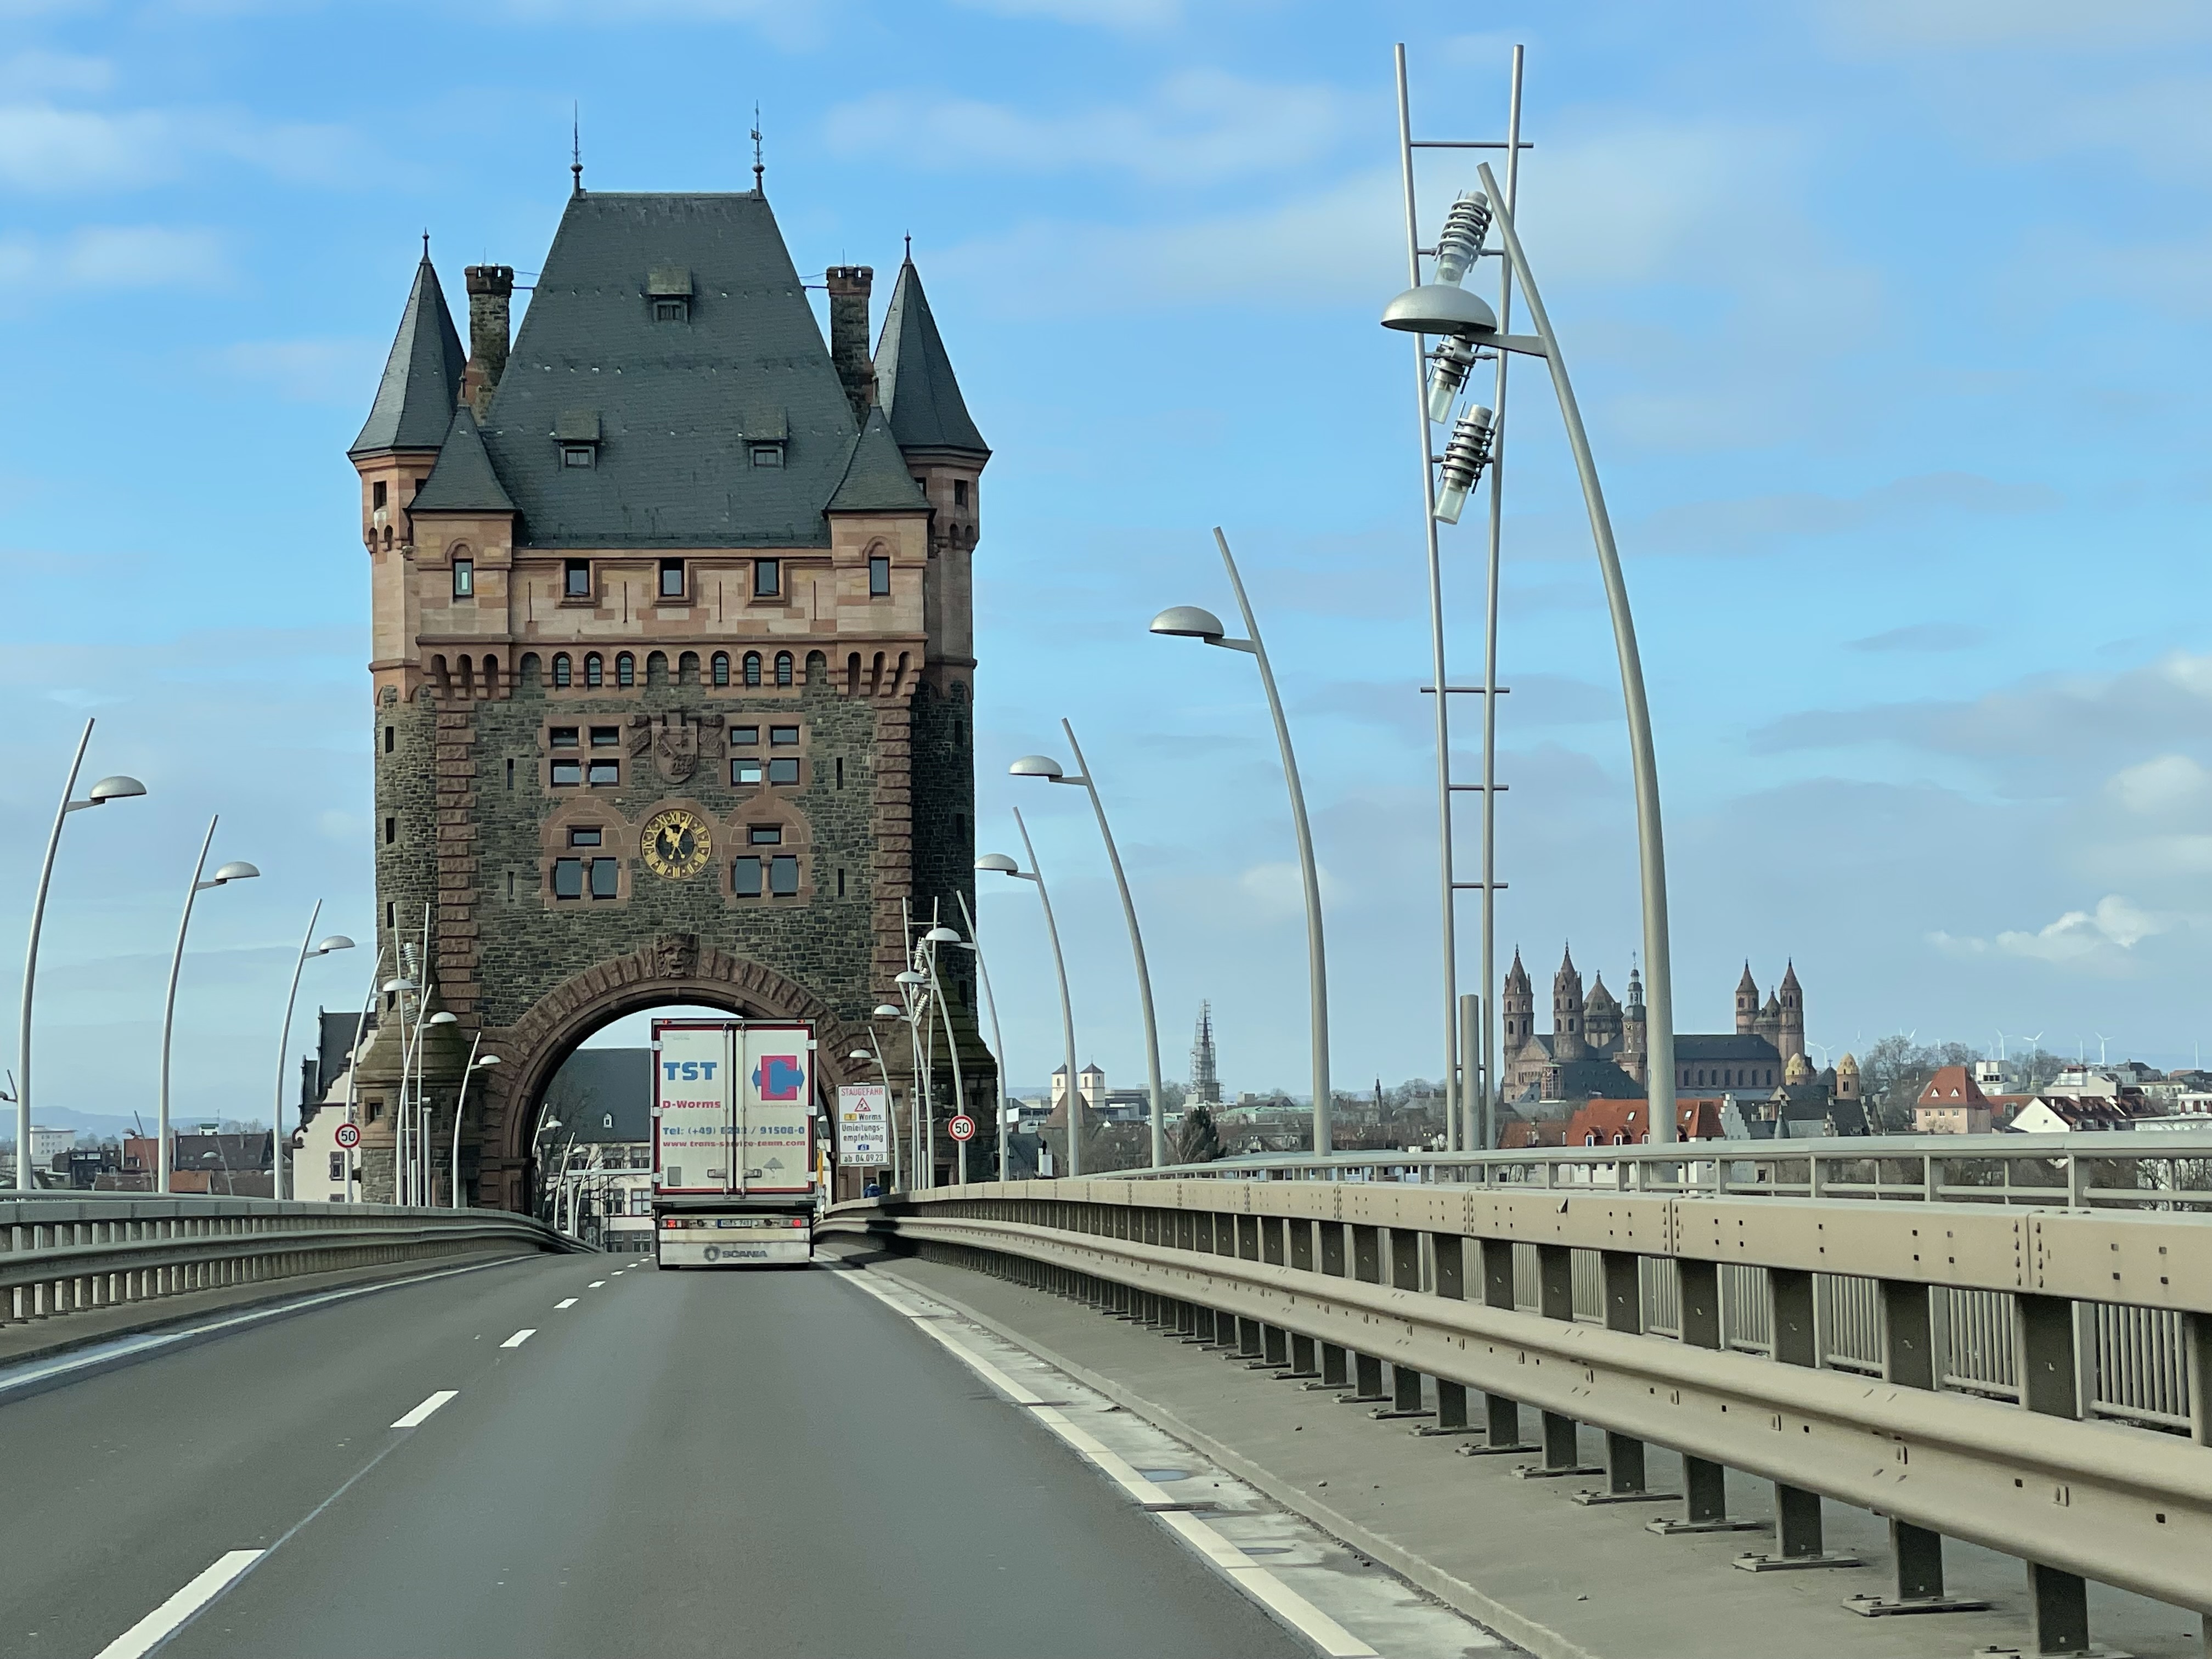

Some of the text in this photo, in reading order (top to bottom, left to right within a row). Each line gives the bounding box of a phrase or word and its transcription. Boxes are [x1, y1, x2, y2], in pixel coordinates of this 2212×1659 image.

[663, 1062, 717, 1081] TST
[841, 1087, 883, 1096] STAUGEFAHR
[663, 1100, 721, 1109] D-Worms
[688, 1126, 715, 1135] (+49)
[842, 1124, 884, 1133] Umleitungs-
[955, 1122, 969, 1133] 50
[341, 1130, 356, 1141] 50
[843, 1133, 883, 1143] empfehlung
[856, 1154, 883, 1162] 04.09.23
